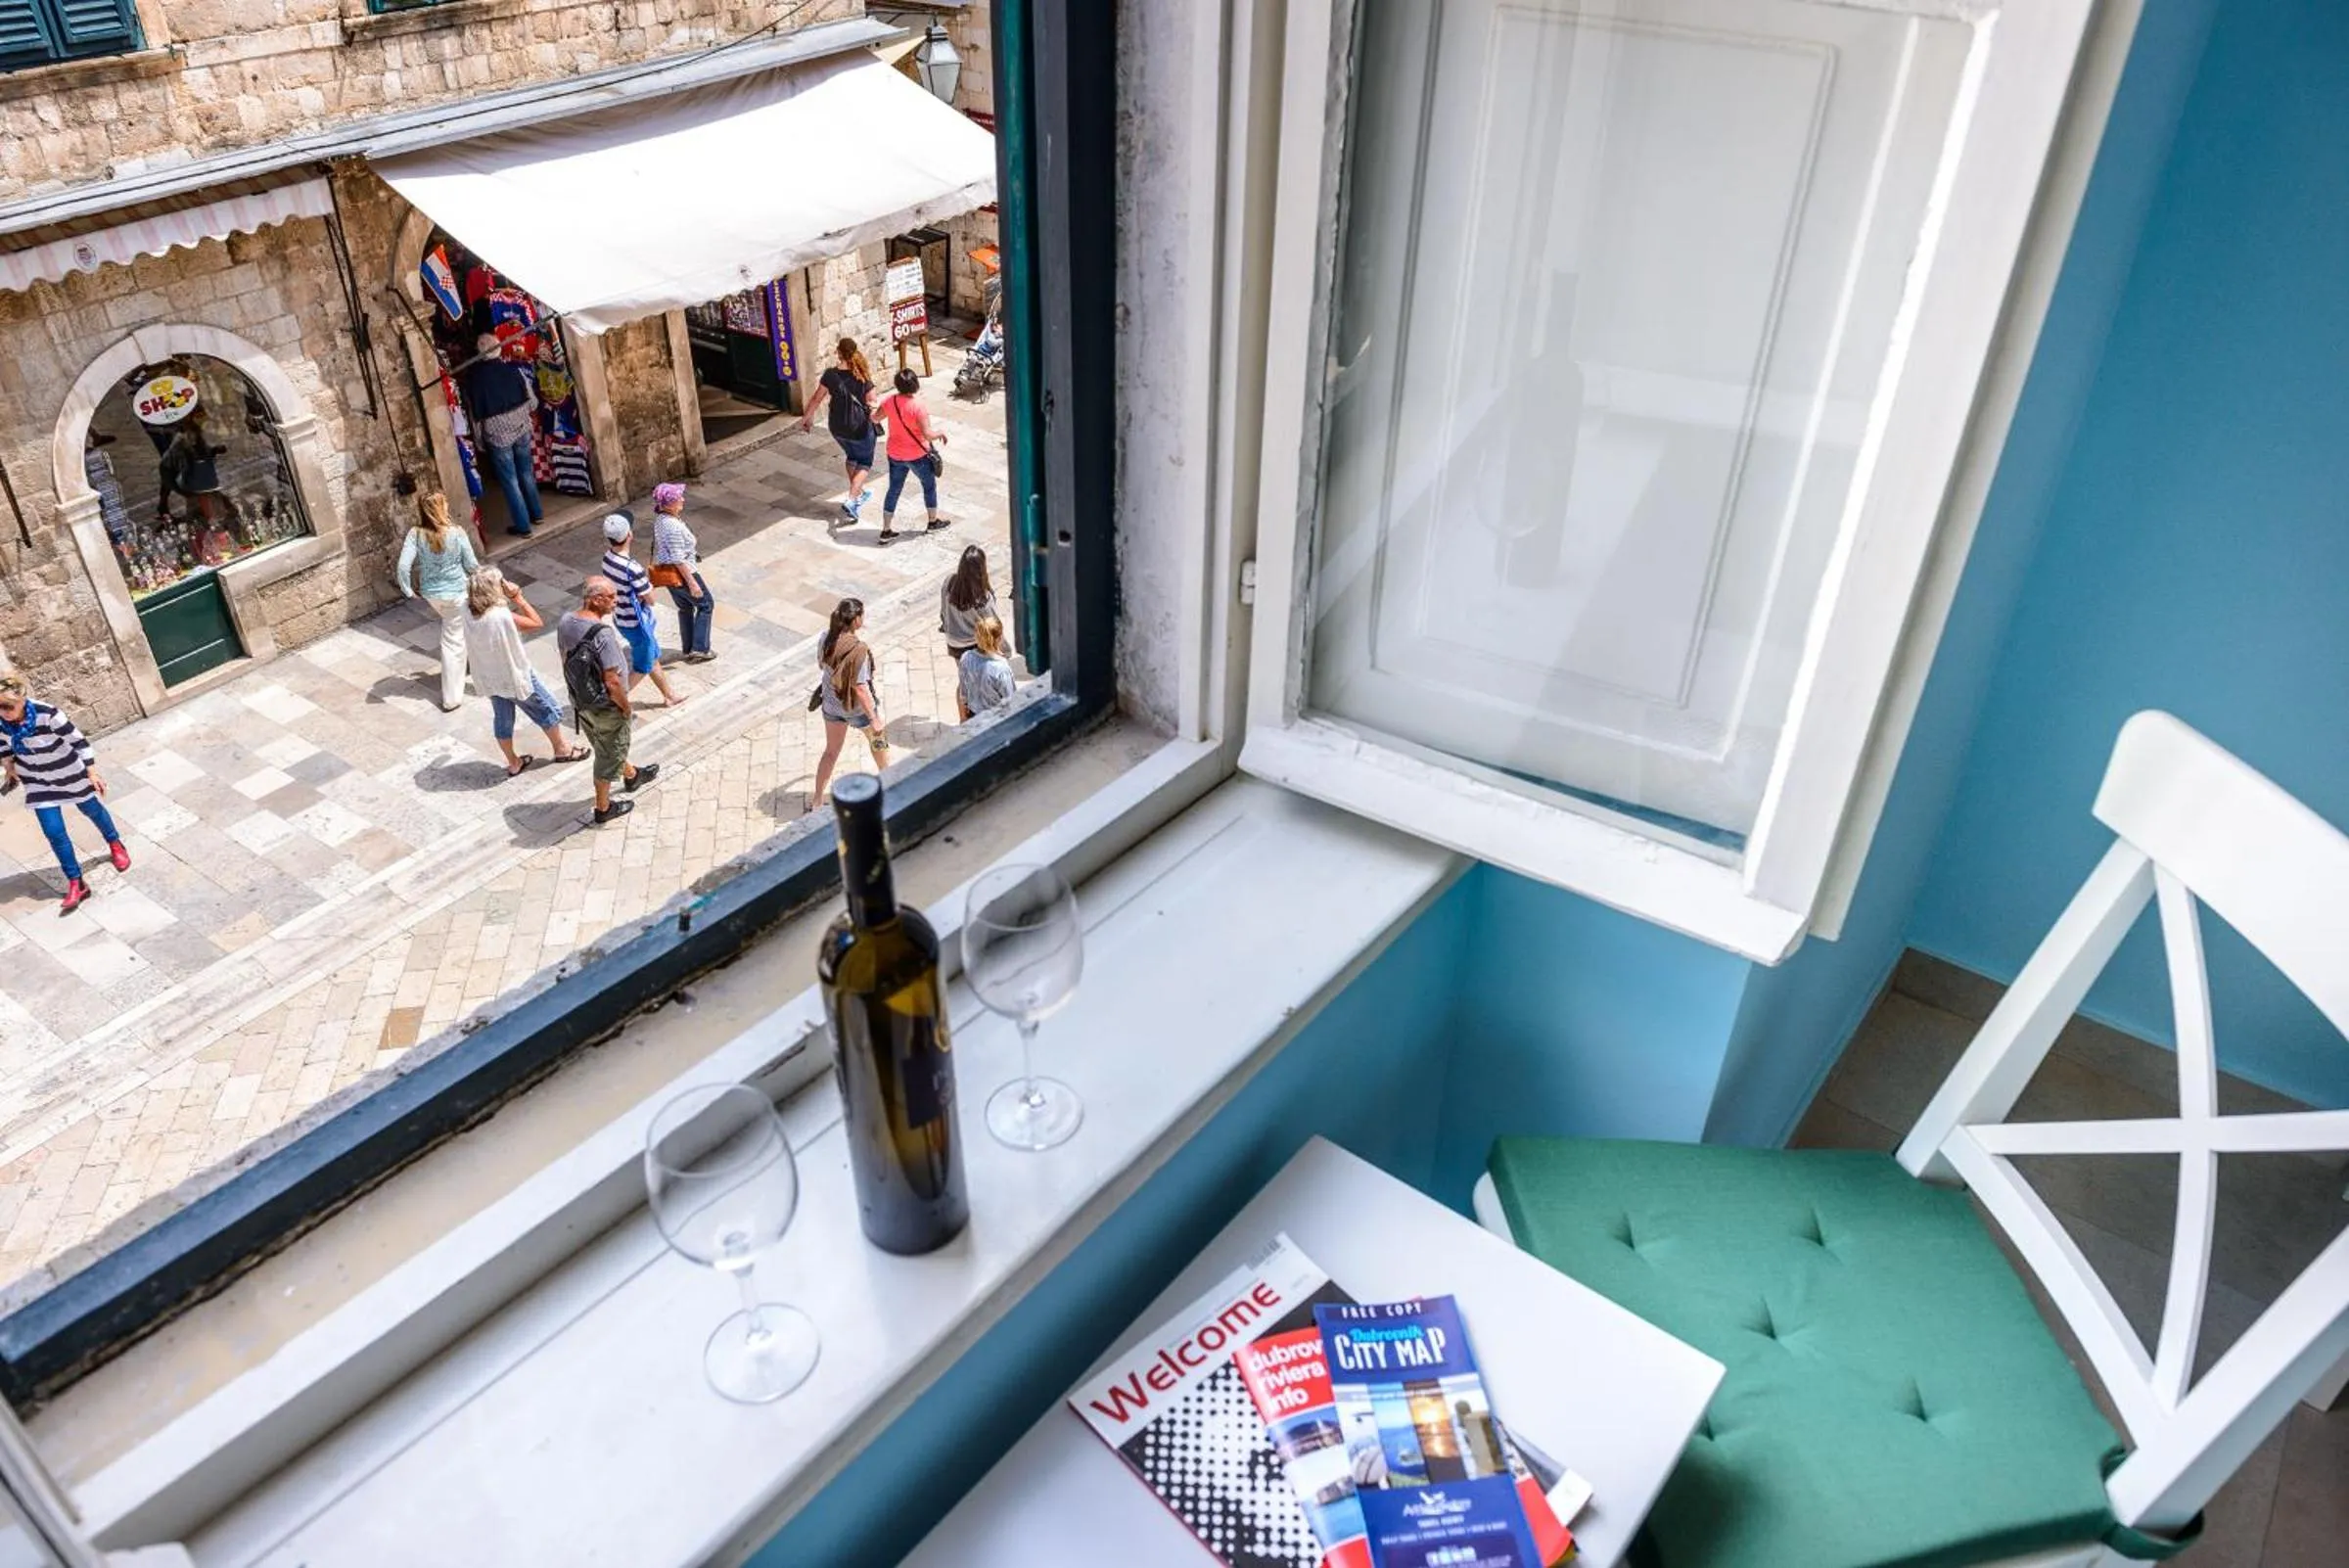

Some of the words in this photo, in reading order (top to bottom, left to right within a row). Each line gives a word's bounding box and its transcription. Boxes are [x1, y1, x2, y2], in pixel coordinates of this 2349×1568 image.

[894, 323, 910, 340] 60
[1341, 1306, 1377, 1318] FREE
[1386, 1302, 1422, 1316] COPY
[1350, 1324, 1424, 1342] Dubrovnik
[1089, 1282, 1282, 1424] Welcome
[1394, 1326, 1447, 1367] MAP
